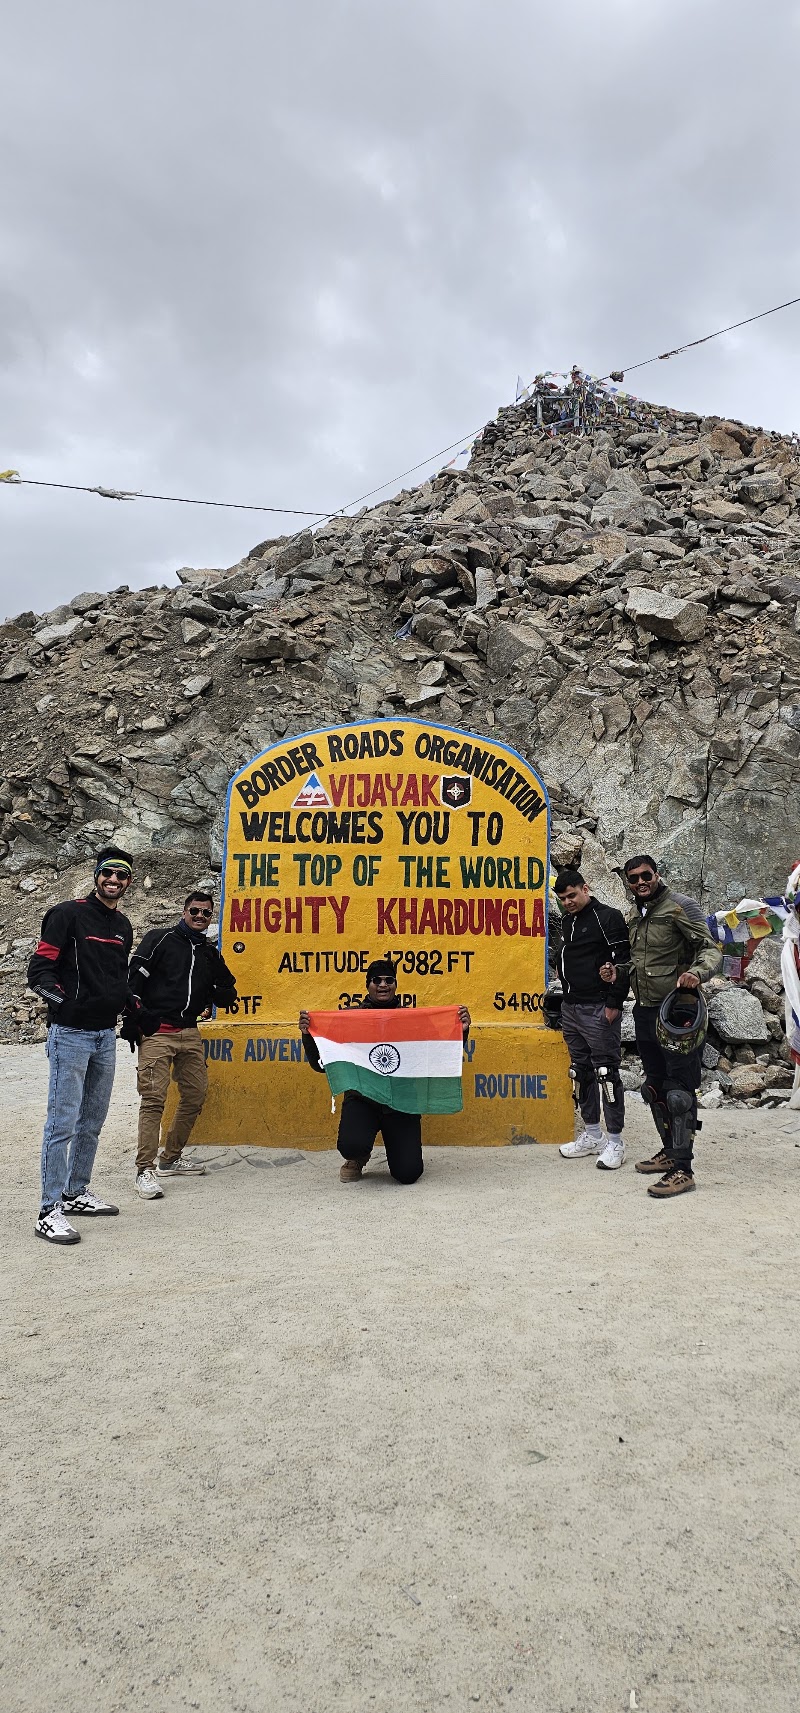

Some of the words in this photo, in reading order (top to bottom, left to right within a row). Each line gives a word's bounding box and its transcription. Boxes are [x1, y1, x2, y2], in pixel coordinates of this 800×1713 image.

[236, 742, 325, 809] BORDER
[327, 729, 404, 763] ROADS
[414, 732, 547, 823] ORGANISATION
[329, 773, 440, 808] VIJAYAK
[239, 811, 384, 845] WELCOMES
[396, 811, 451, 846] YOU
[467, 811, 504, 847] TO
[233, 853, 281, 887] THE
[293, 853, 343, 887] TOP
[353, 854, 382, 887] OF
[398, 855, 451, 889] THE
[460, 856, 545, 891] WORLD
[229, 895, 351, 934] MIGHTY
[377, 897, 546, 938] KHARDUNGLA
[278, 951, 370, 973] ALTITUDE
[447, 951, 475, 973] FT
[244, 1038, 309, 1062] ADVEN
[474, 1073, 548, 1099] ROUTINE
